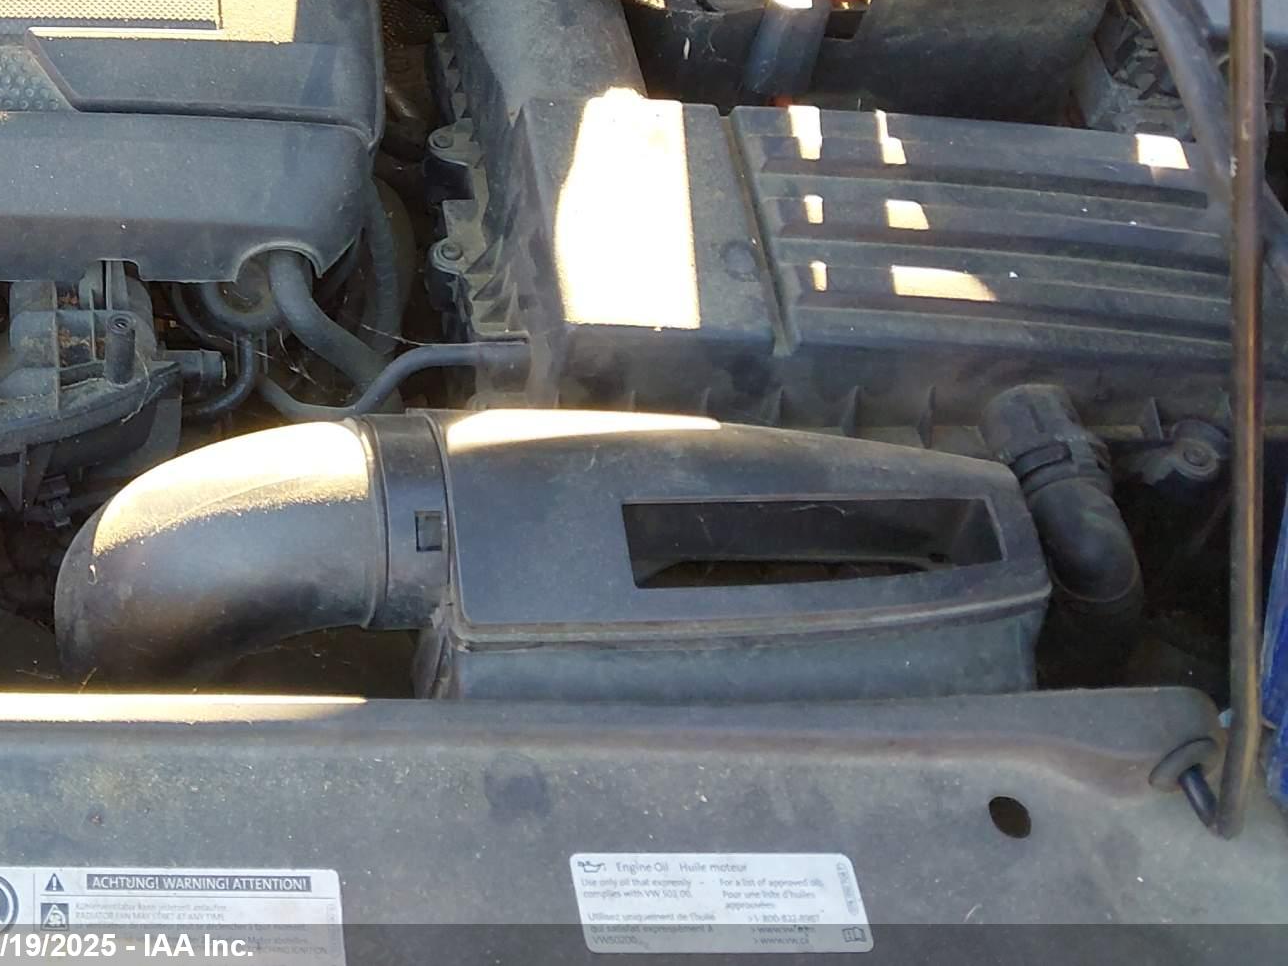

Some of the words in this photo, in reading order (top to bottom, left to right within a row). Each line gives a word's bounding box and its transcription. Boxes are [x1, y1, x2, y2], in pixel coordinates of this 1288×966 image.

[615, 861, 652, 875] Engine
[655, 861, 669, 872] Oil
[679, 861, 706, 872] Huile
[710, 864, 747, 872] moteur
[92, 876, 159, 890] ACHTUNG!
[162, 876, 230, 890] WARNING!
[232, 878, 307, 891] ATTENTION!
